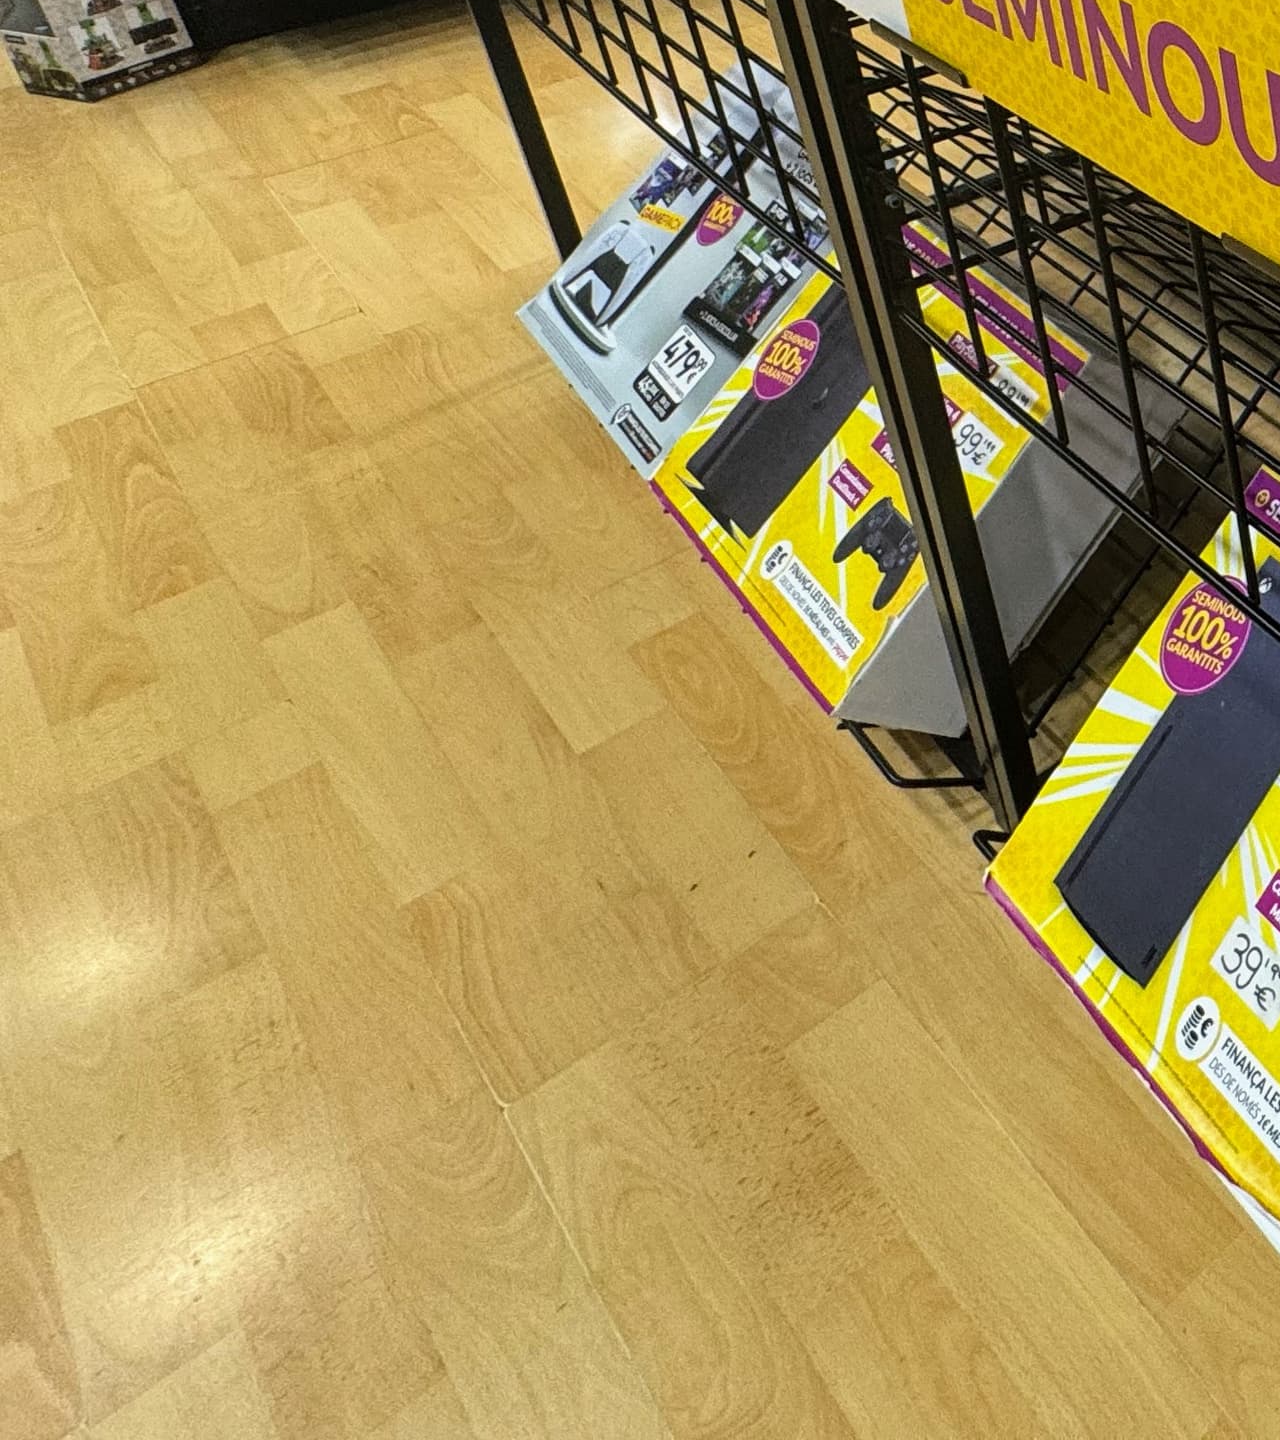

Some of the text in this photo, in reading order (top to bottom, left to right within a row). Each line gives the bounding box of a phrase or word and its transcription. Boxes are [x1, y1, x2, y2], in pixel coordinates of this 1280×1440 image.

[767, 339, 808, 374] 100%
[1192, 588, 1247, 625] SEMINOUS
[1172, 603, 1239, 660] 100%
[1165, 636, 1225, 677] GARANTITS
[1220, 1037, 1267, 1095] FINANÇA
